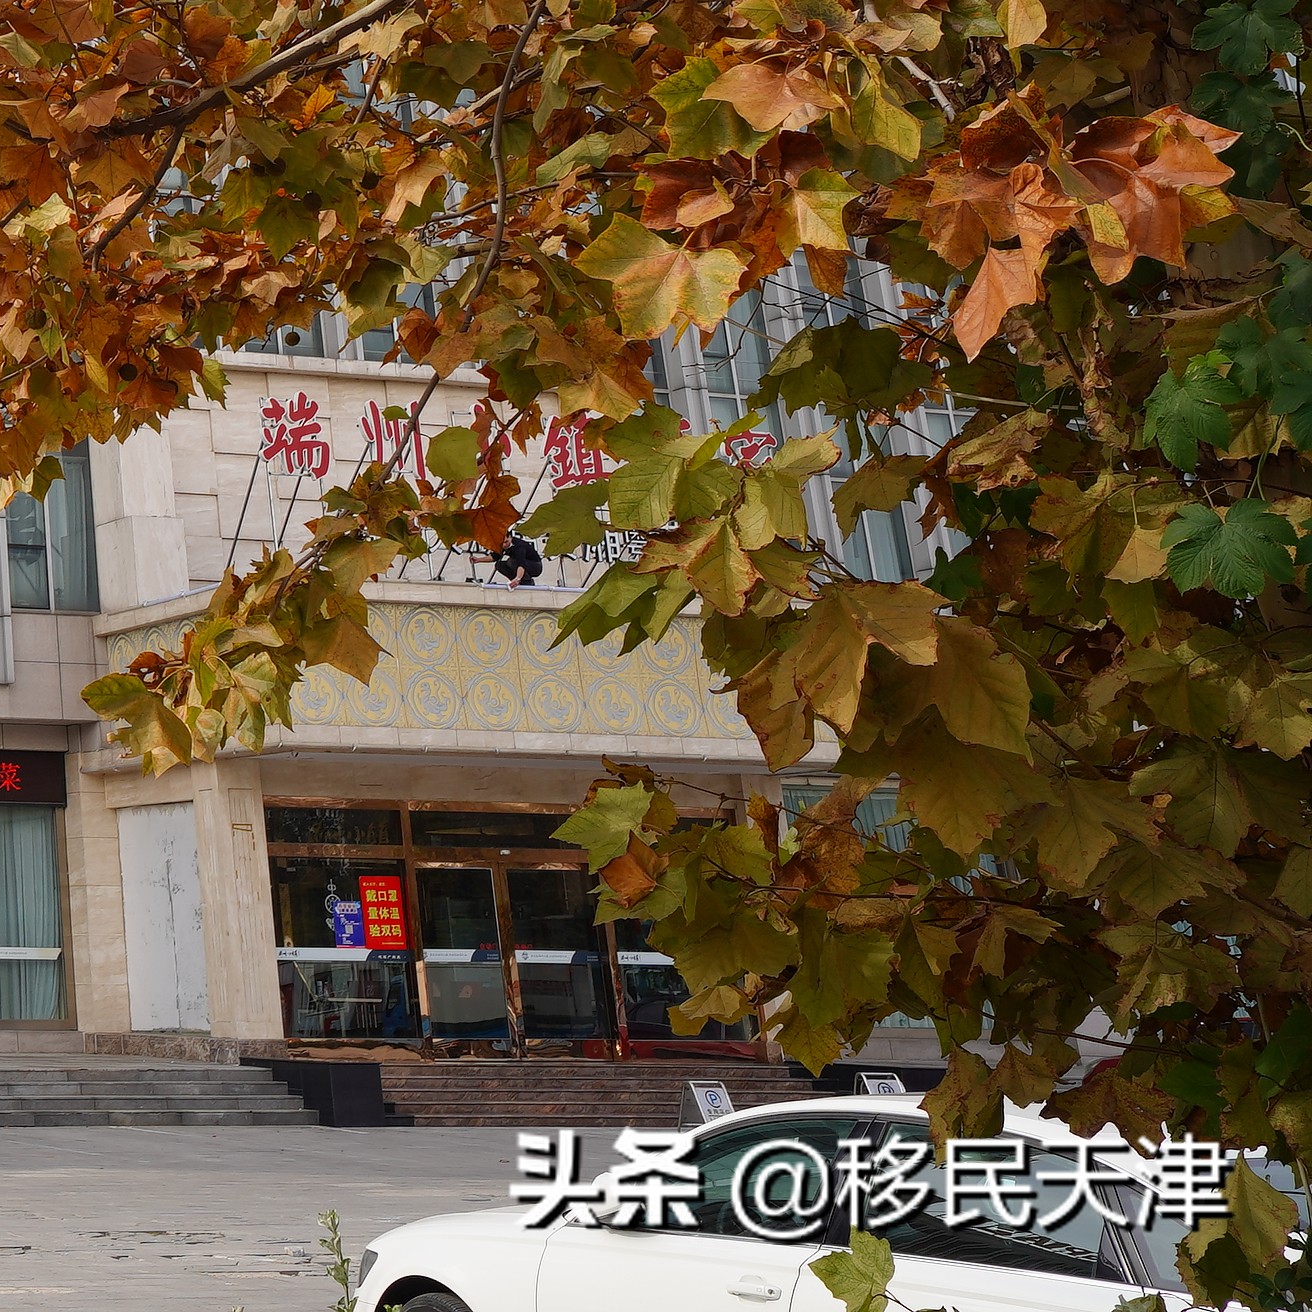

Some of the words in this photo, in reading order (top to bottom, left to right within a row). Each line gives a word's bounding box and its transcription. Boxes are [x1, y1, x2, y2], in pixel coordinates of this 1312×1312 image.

[365, 890, 398, 902] 戴口罩
[367, 907, 400, 919] 量体温
[369, 924, 402, 937] 验双码
